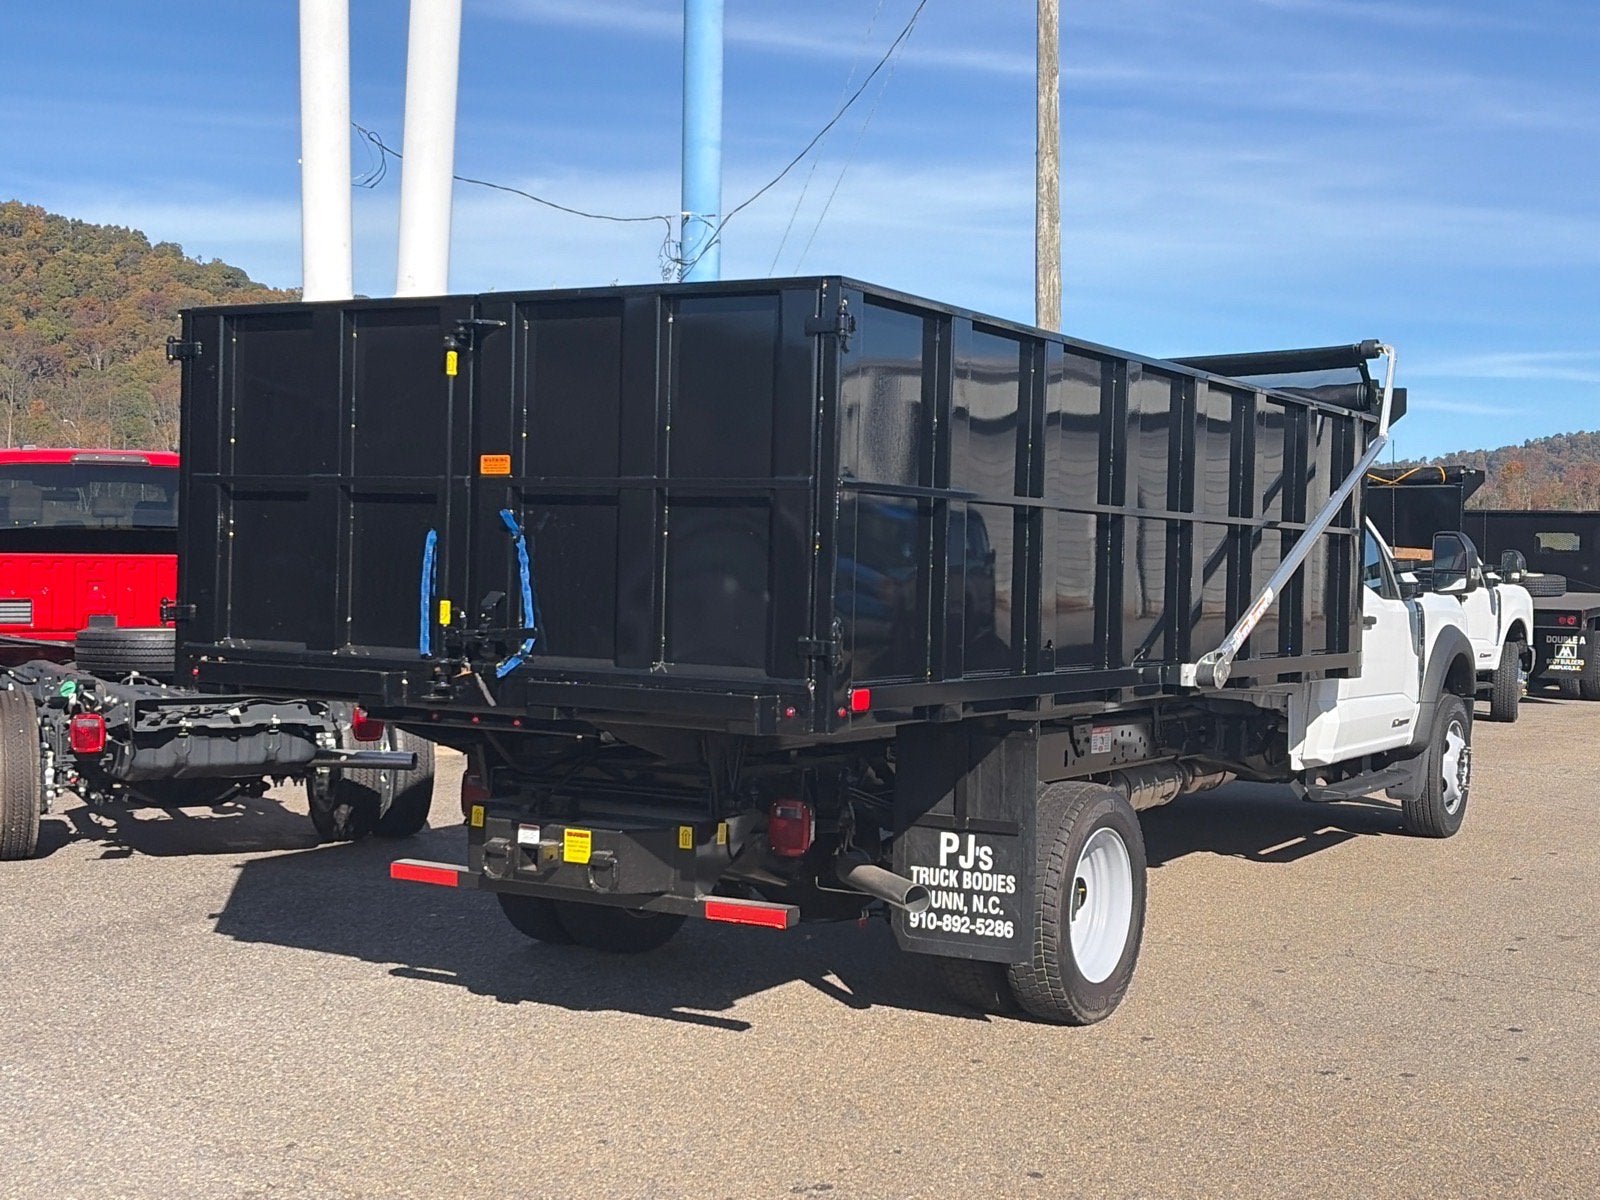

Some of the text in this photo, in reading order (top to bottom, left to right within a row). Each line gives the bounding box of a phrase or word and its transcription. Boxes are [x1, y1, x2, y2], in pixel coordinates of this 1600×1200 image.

[1546, 635, 1586, 645] DOUBLE A
[910, 866, 1016, 894] TRUCK BODIES
[930, 890, 1004, 915] UNN, N.C.
[909, 911, 1014, 939] 910-892-5286
